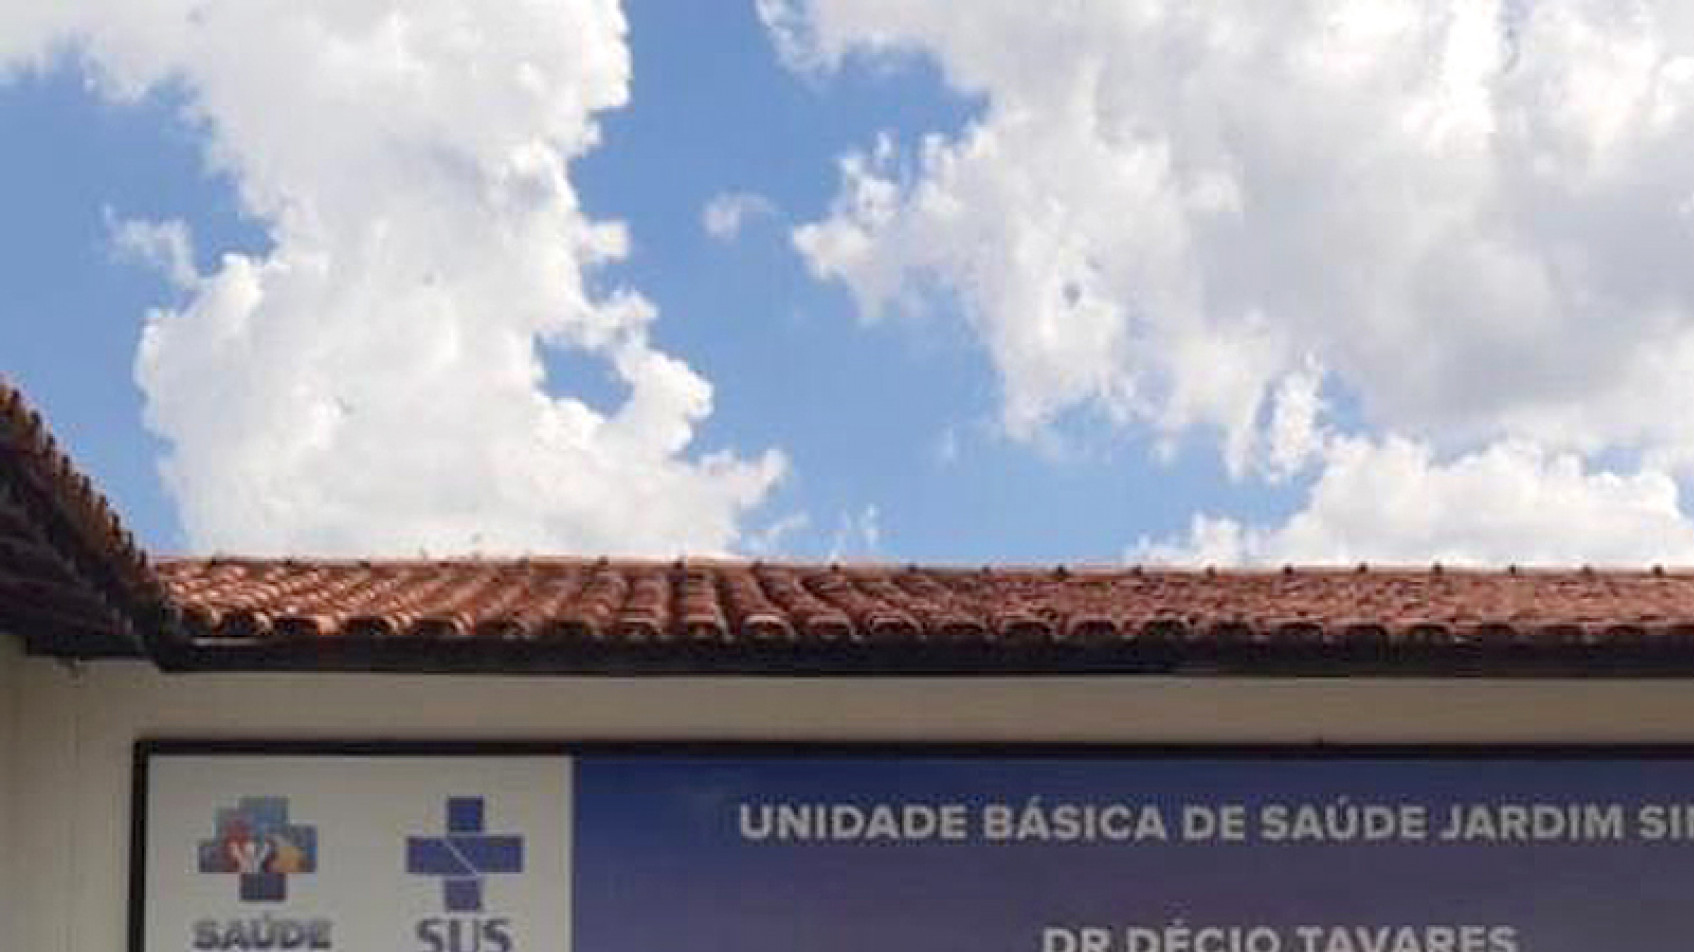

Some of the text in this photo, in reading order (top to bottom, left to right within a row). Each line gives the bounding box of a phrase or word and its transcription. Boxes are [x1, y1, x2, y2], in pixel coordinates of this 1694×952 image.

[739, 803, 968, 840] UNIDADE
[984, 797, 1167, 840] BÁSICA
[1183, 804, 1246, 839] DE
[1259, 798, 1428, 840] SAÚDE
[1439, 804, 1625, 840] JARDIM
